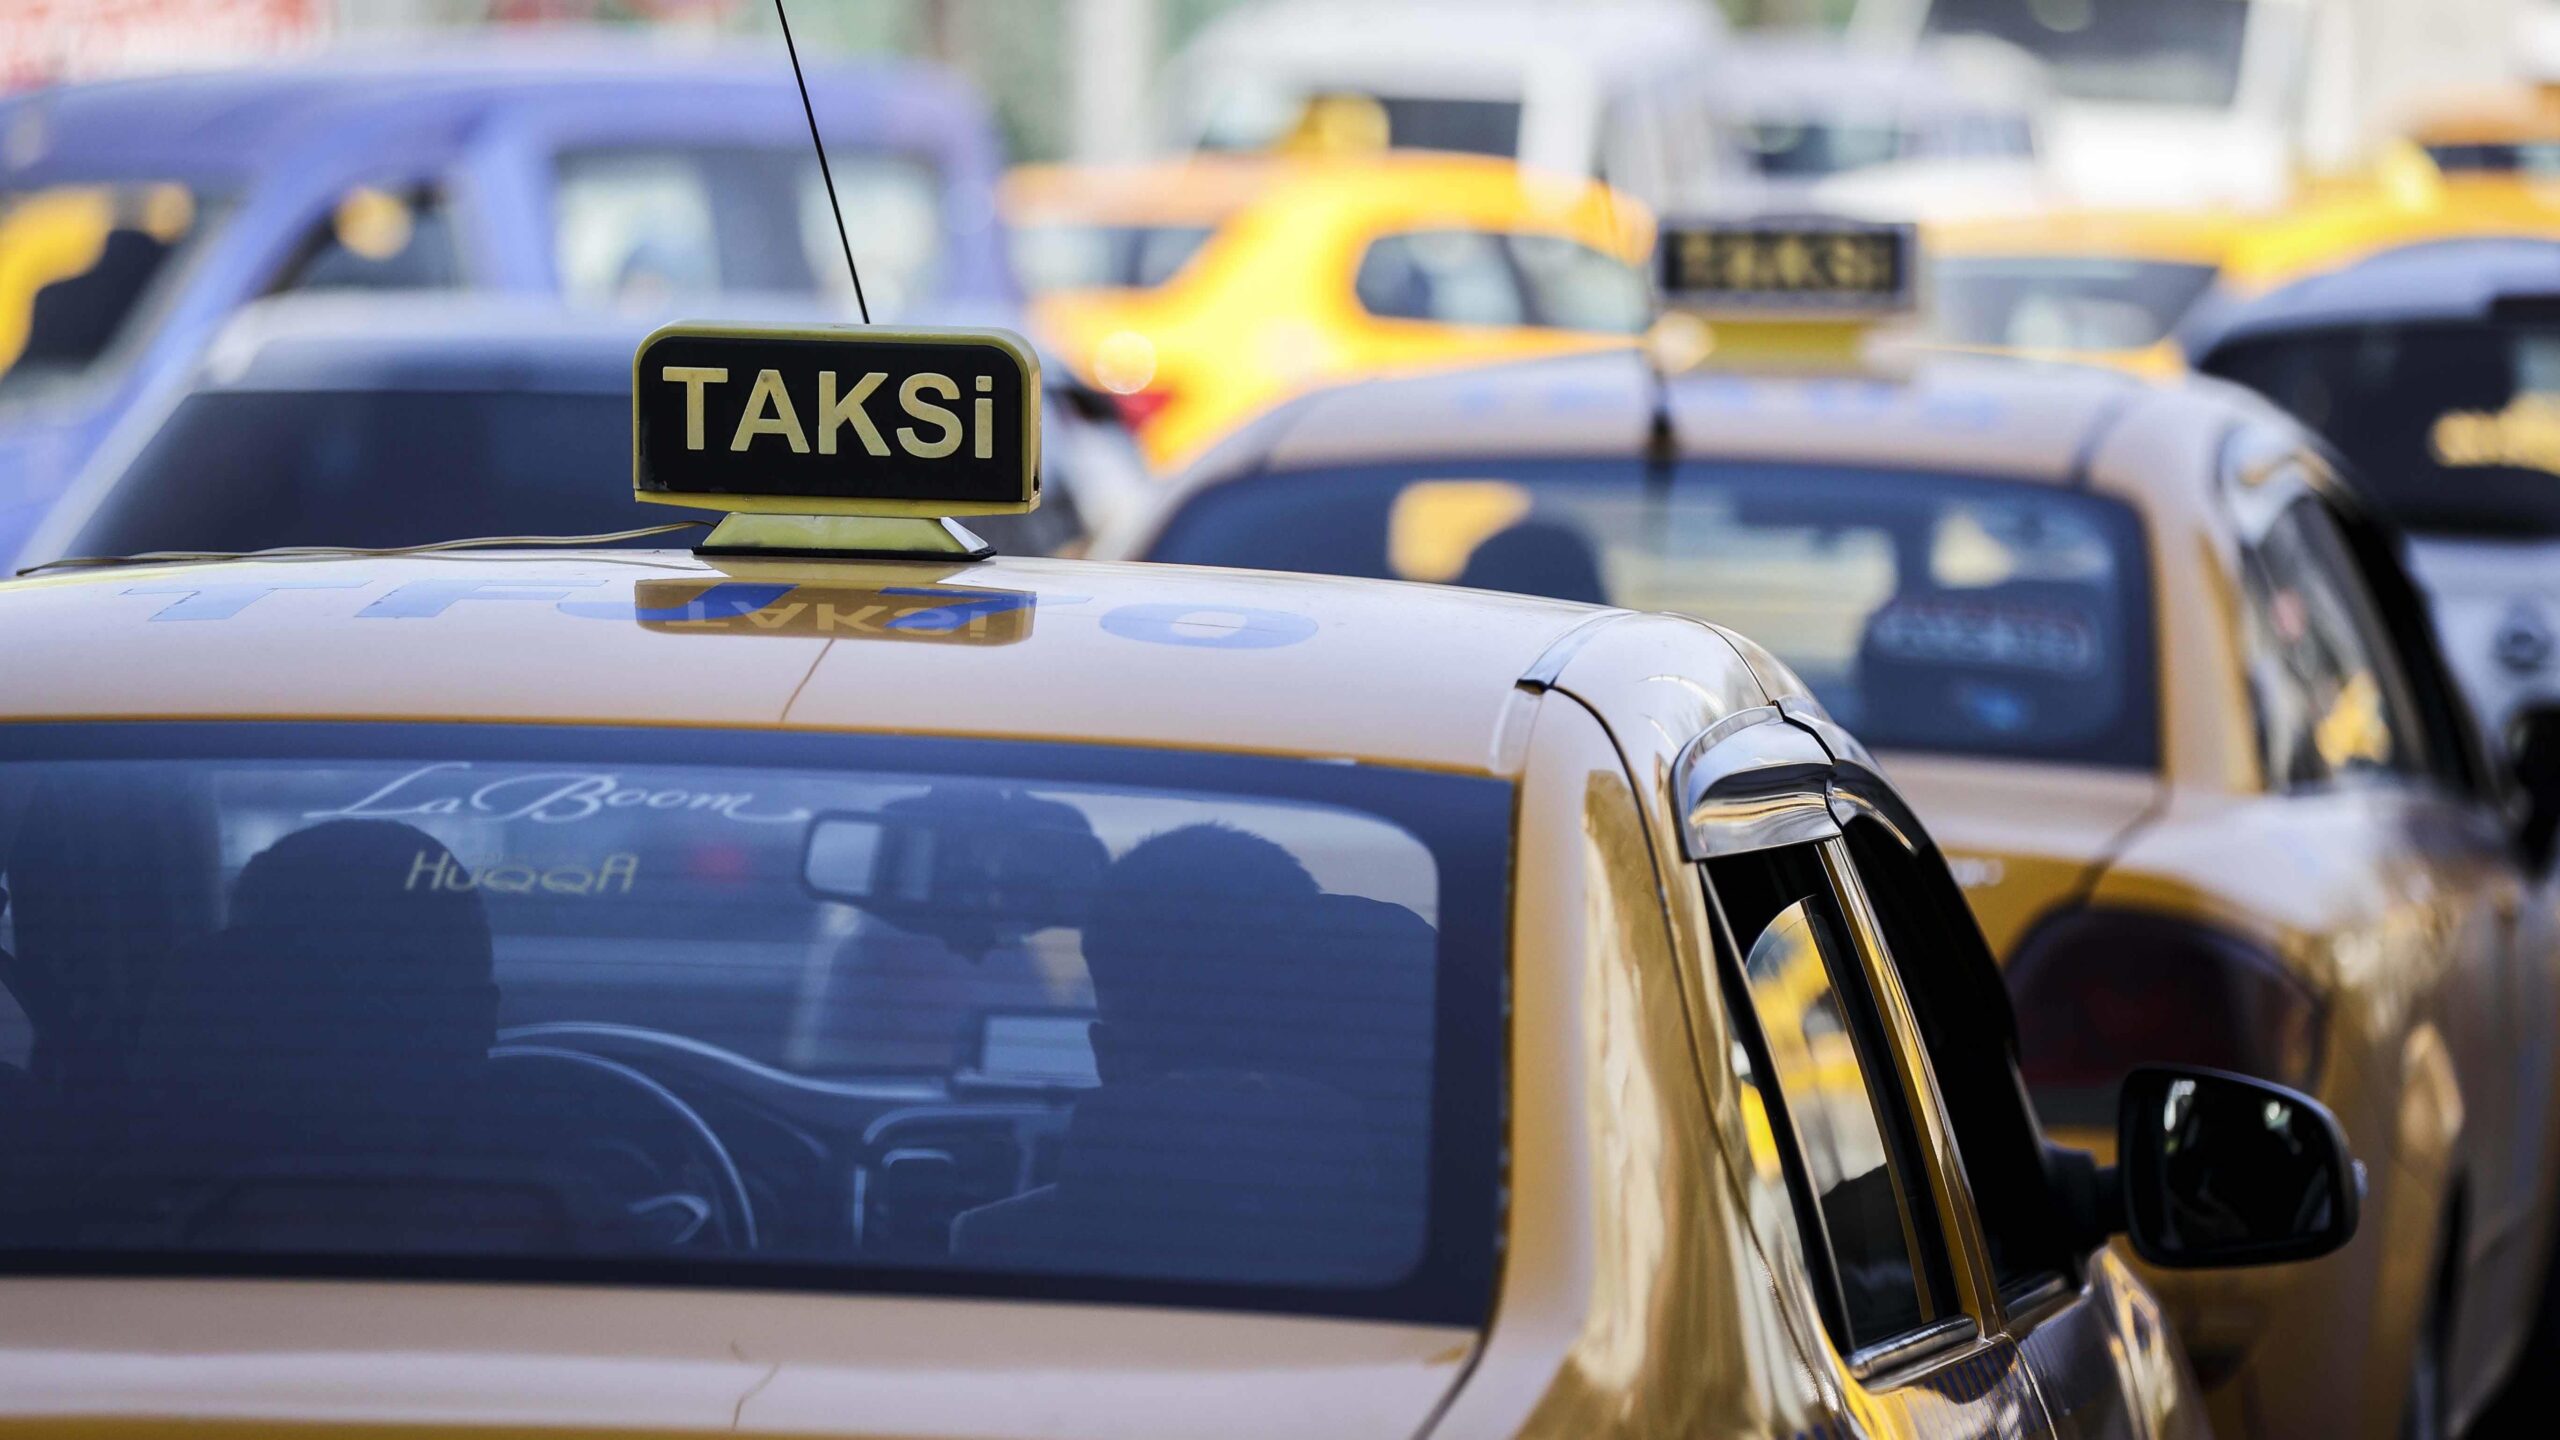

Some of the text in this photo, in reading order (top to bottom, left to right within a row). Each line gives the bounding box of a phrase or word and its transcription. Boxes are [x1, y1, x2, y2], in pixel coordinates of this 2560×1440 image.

[663, 366, 992, 459] TAKSi
[303, 762, 812, 823] La Boom
